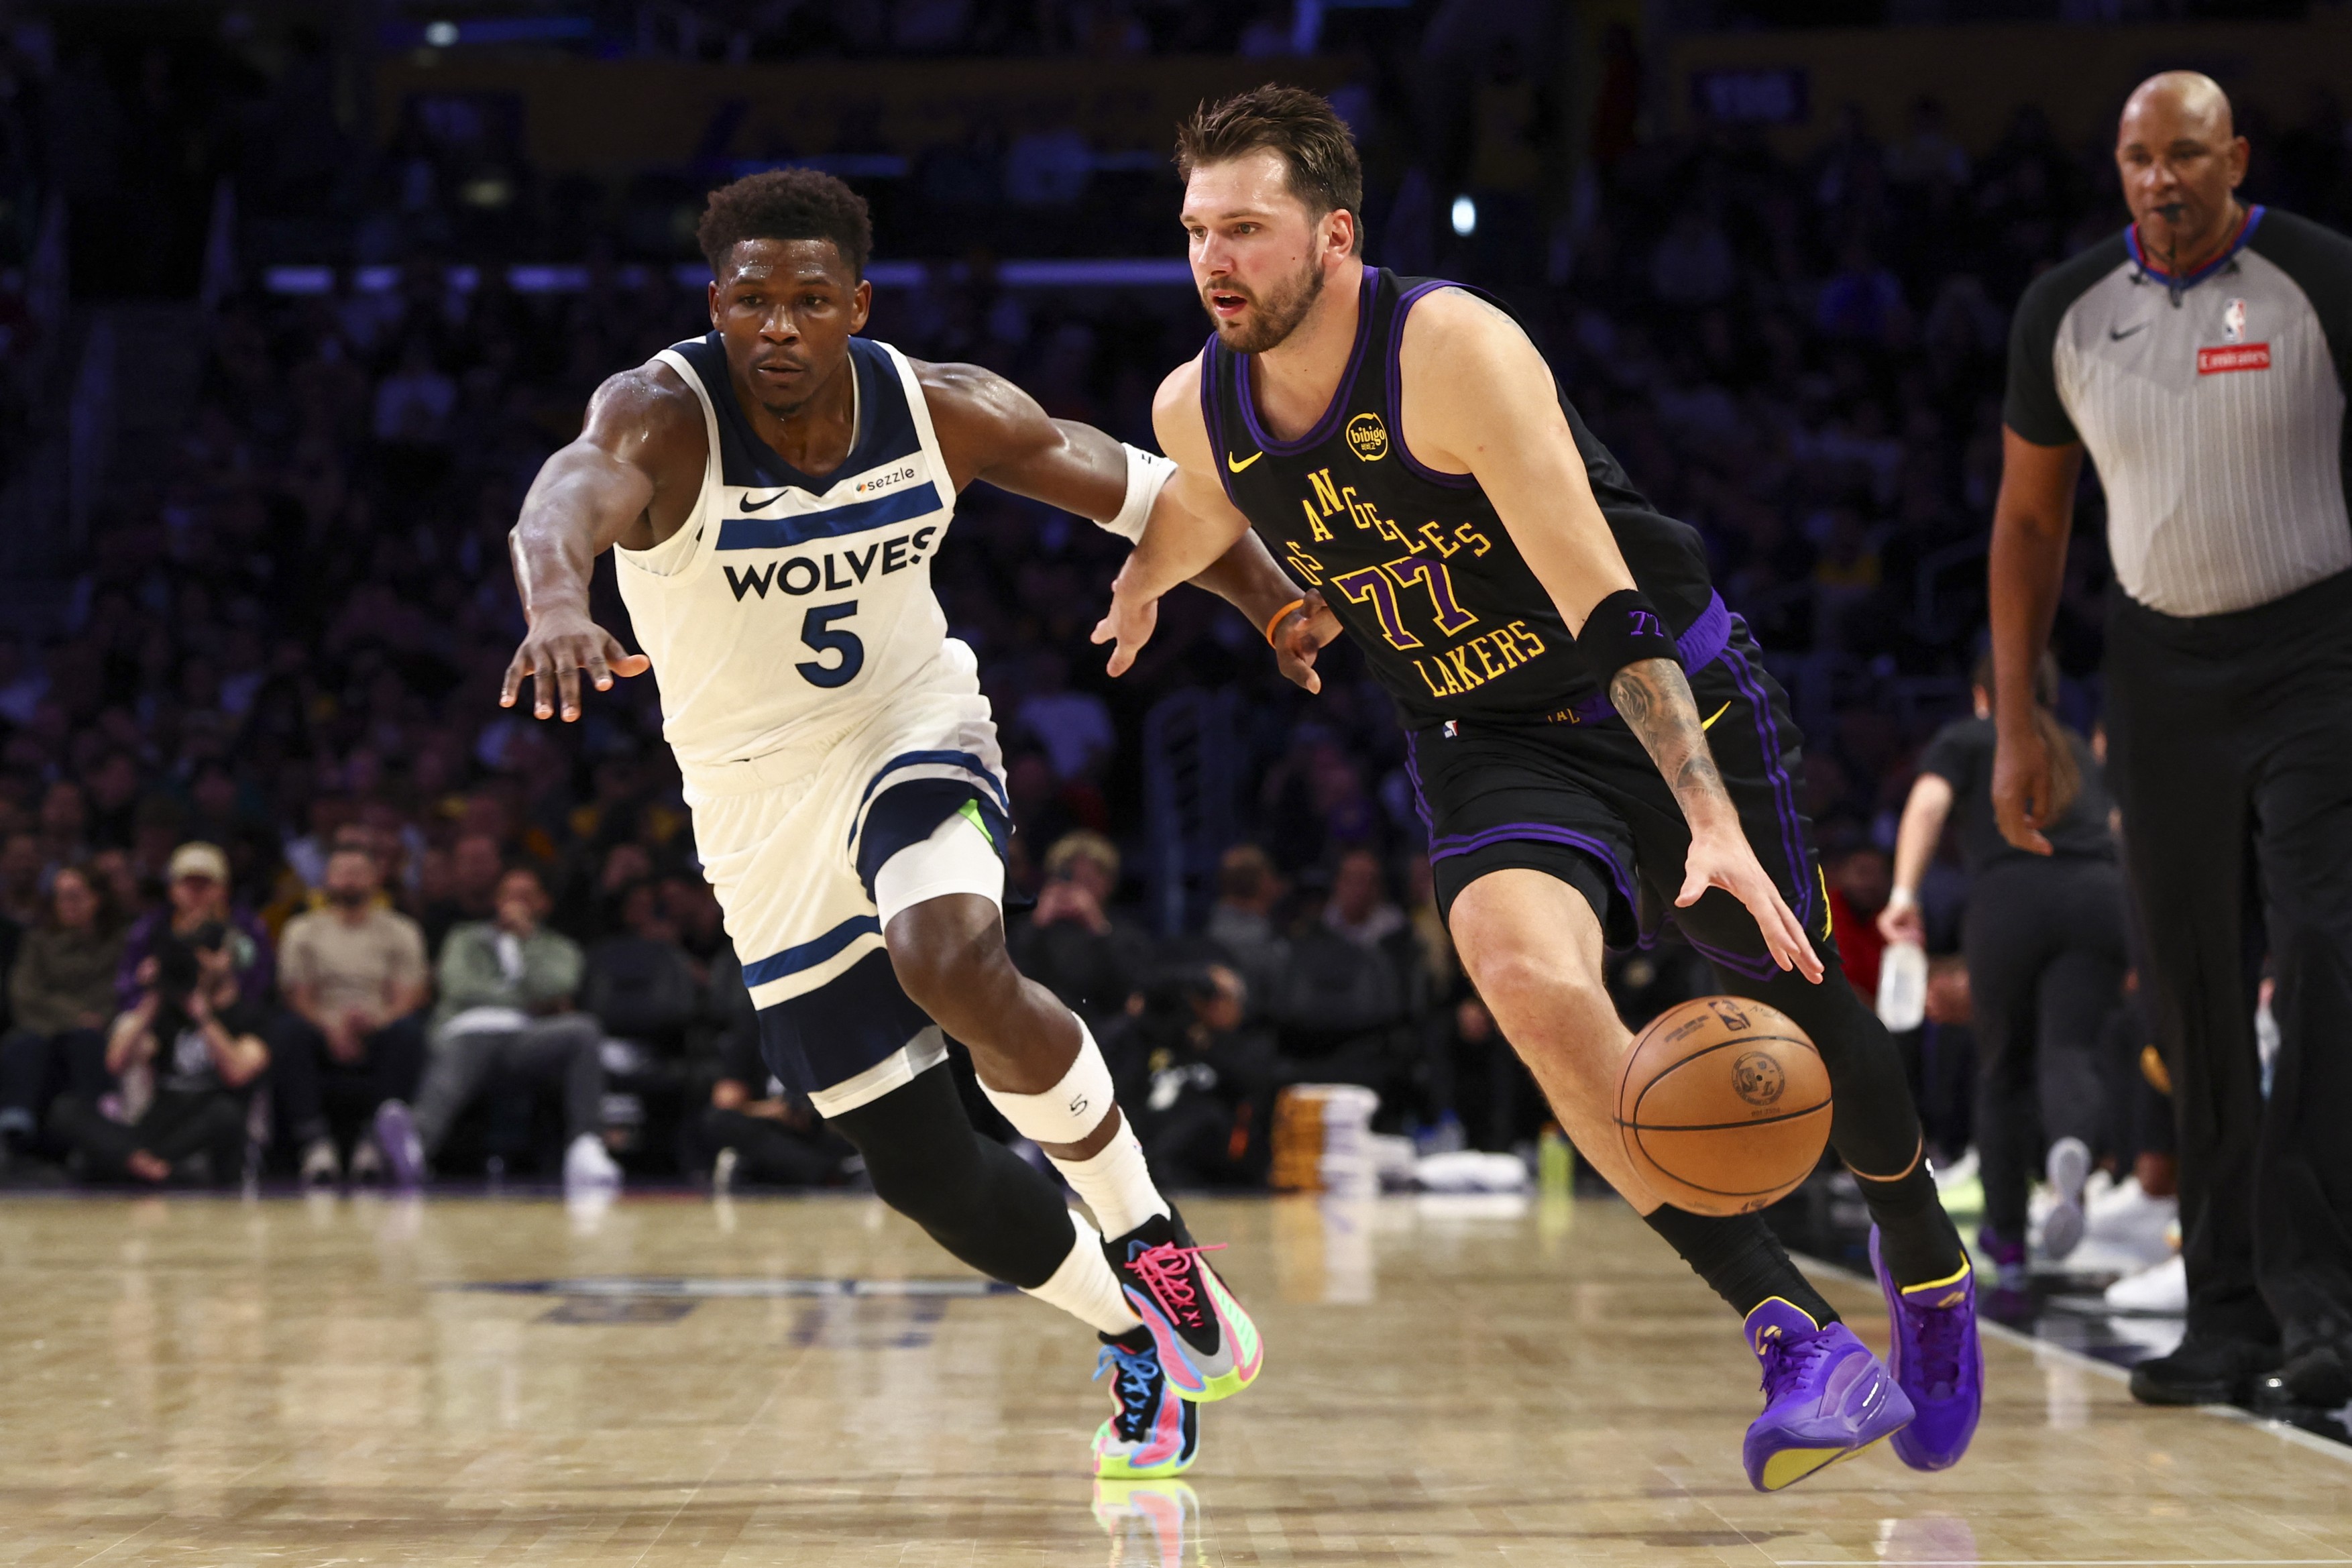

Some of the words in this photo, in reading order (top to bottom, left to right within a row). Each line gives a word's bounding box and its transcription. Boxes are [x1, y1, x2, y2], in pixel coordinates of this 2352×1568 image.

[1350, 425, 1386, 446] bibigo
[867, 467, 915, 491] sezzle
[1302, 467, 1491, 559] ANGELES
[723, 526, 937, 602] WOLVES
[1286, 541, 1324, 585] OS
[1330, 556, 1479, 651] 77
[1628, 610, 1664, 637] 77
[795, 600, 864, 688] 5
[1412, 620, 1546, 697] LAKERS
[1070, 1094, 1088, 1117] 5
